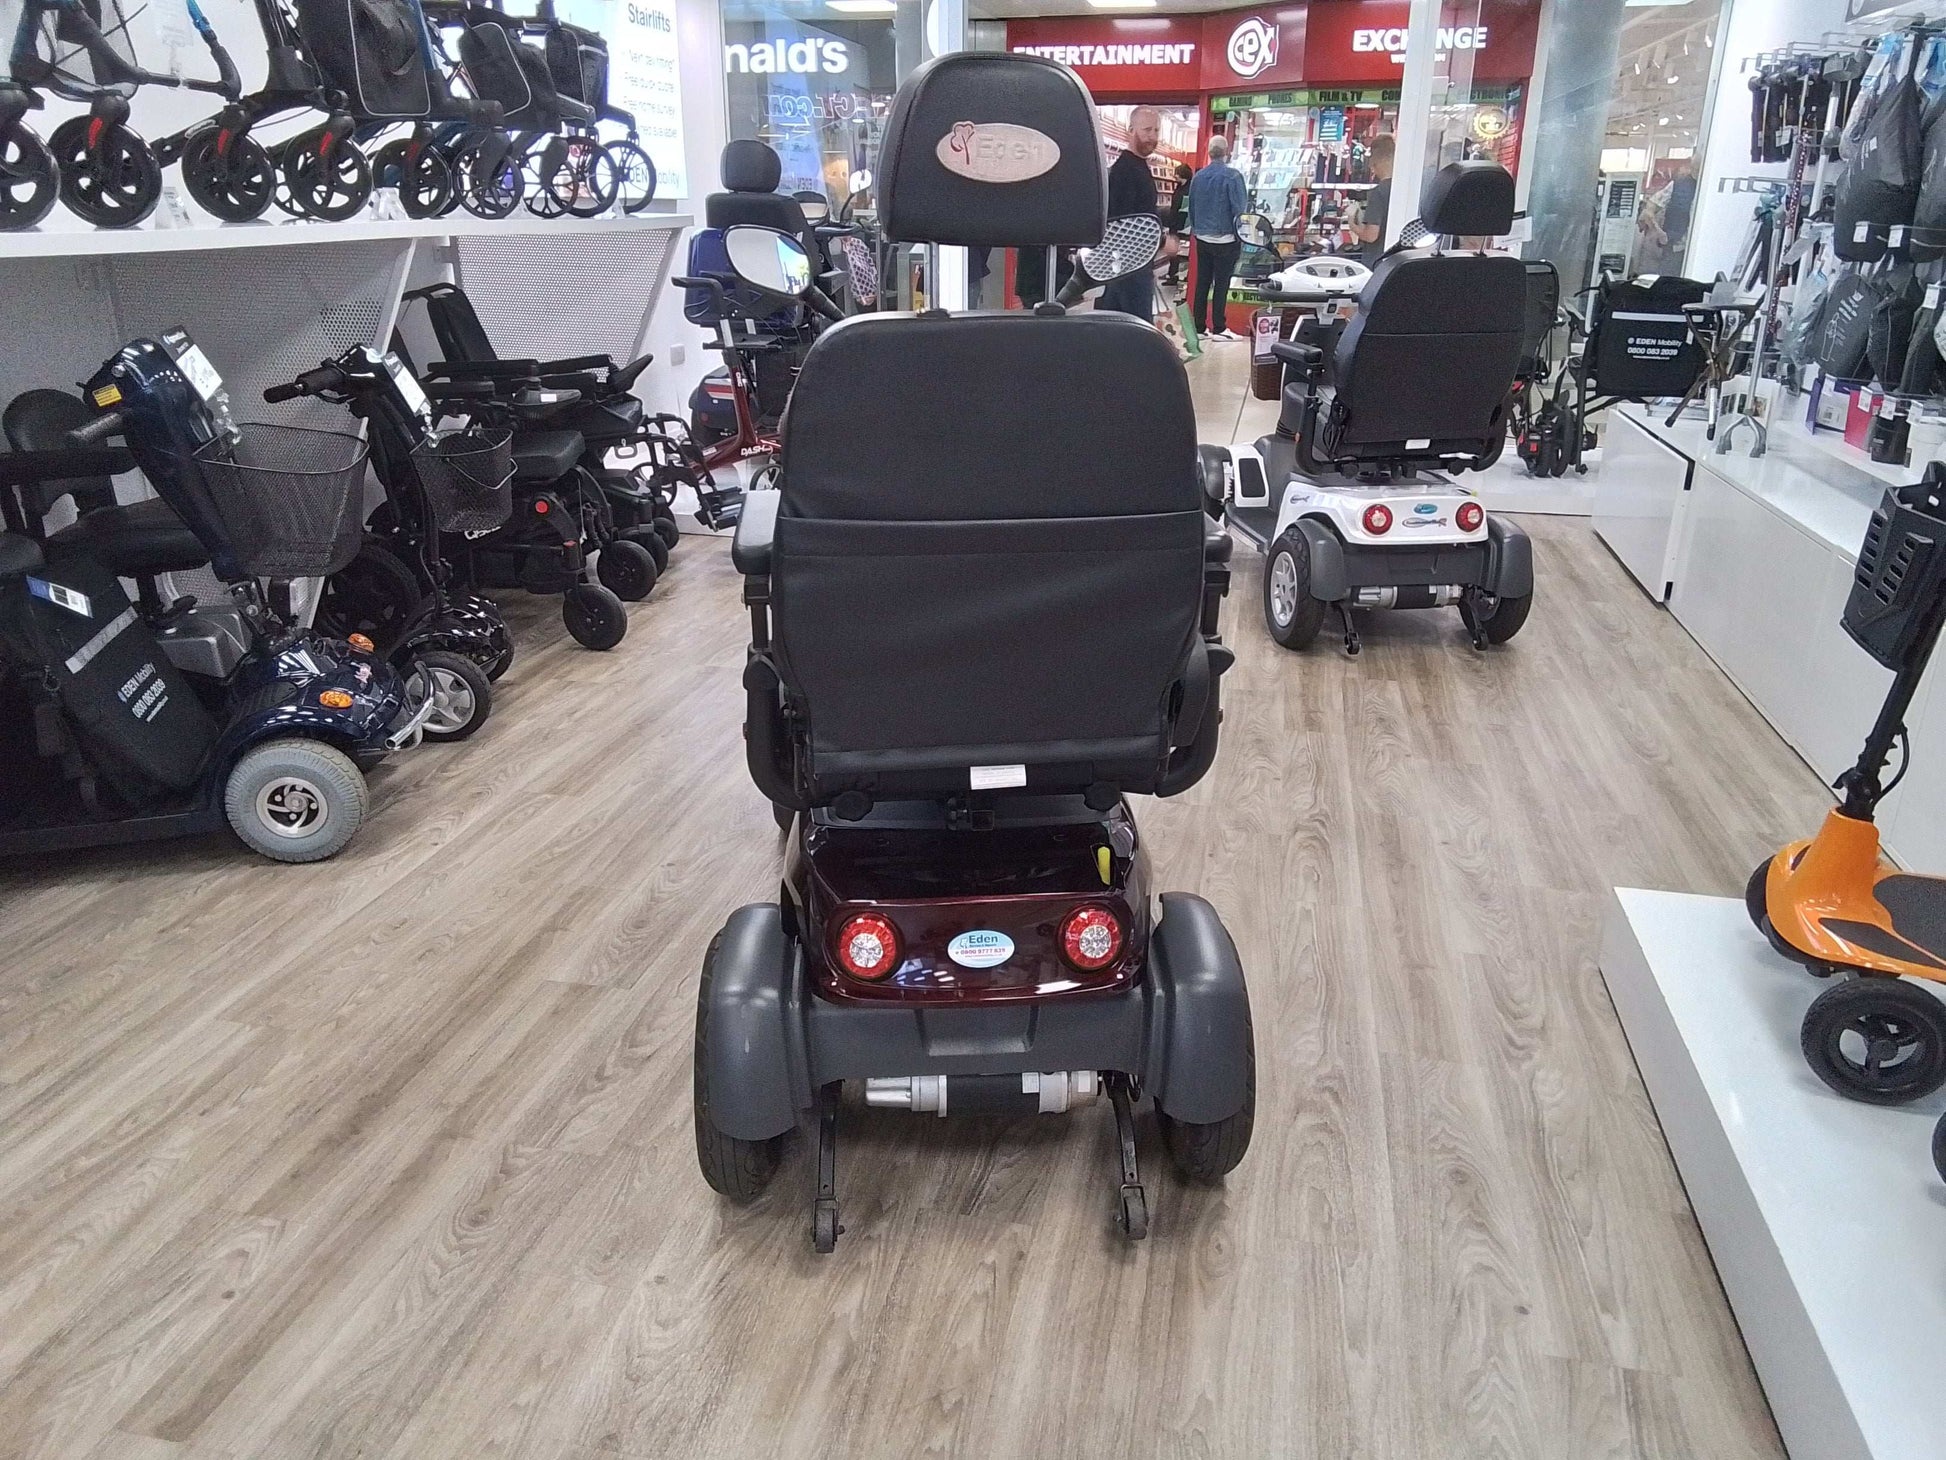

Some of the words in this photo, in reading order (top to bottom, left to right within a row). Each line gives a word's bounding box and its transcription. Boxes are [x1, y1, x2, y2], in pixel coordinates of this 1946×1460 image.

[628, 2, 671, 33] Stairlifts
[1319, 90, 1340, 102] FILM
[1350, 90, 1363, 102] TV
[976, 132, 1043, 160] Eden
[1657, 339, 1682, 348] Mobility
[121, 677, 140, 698] EDEN
[968, 934, 998, 944] Eden
